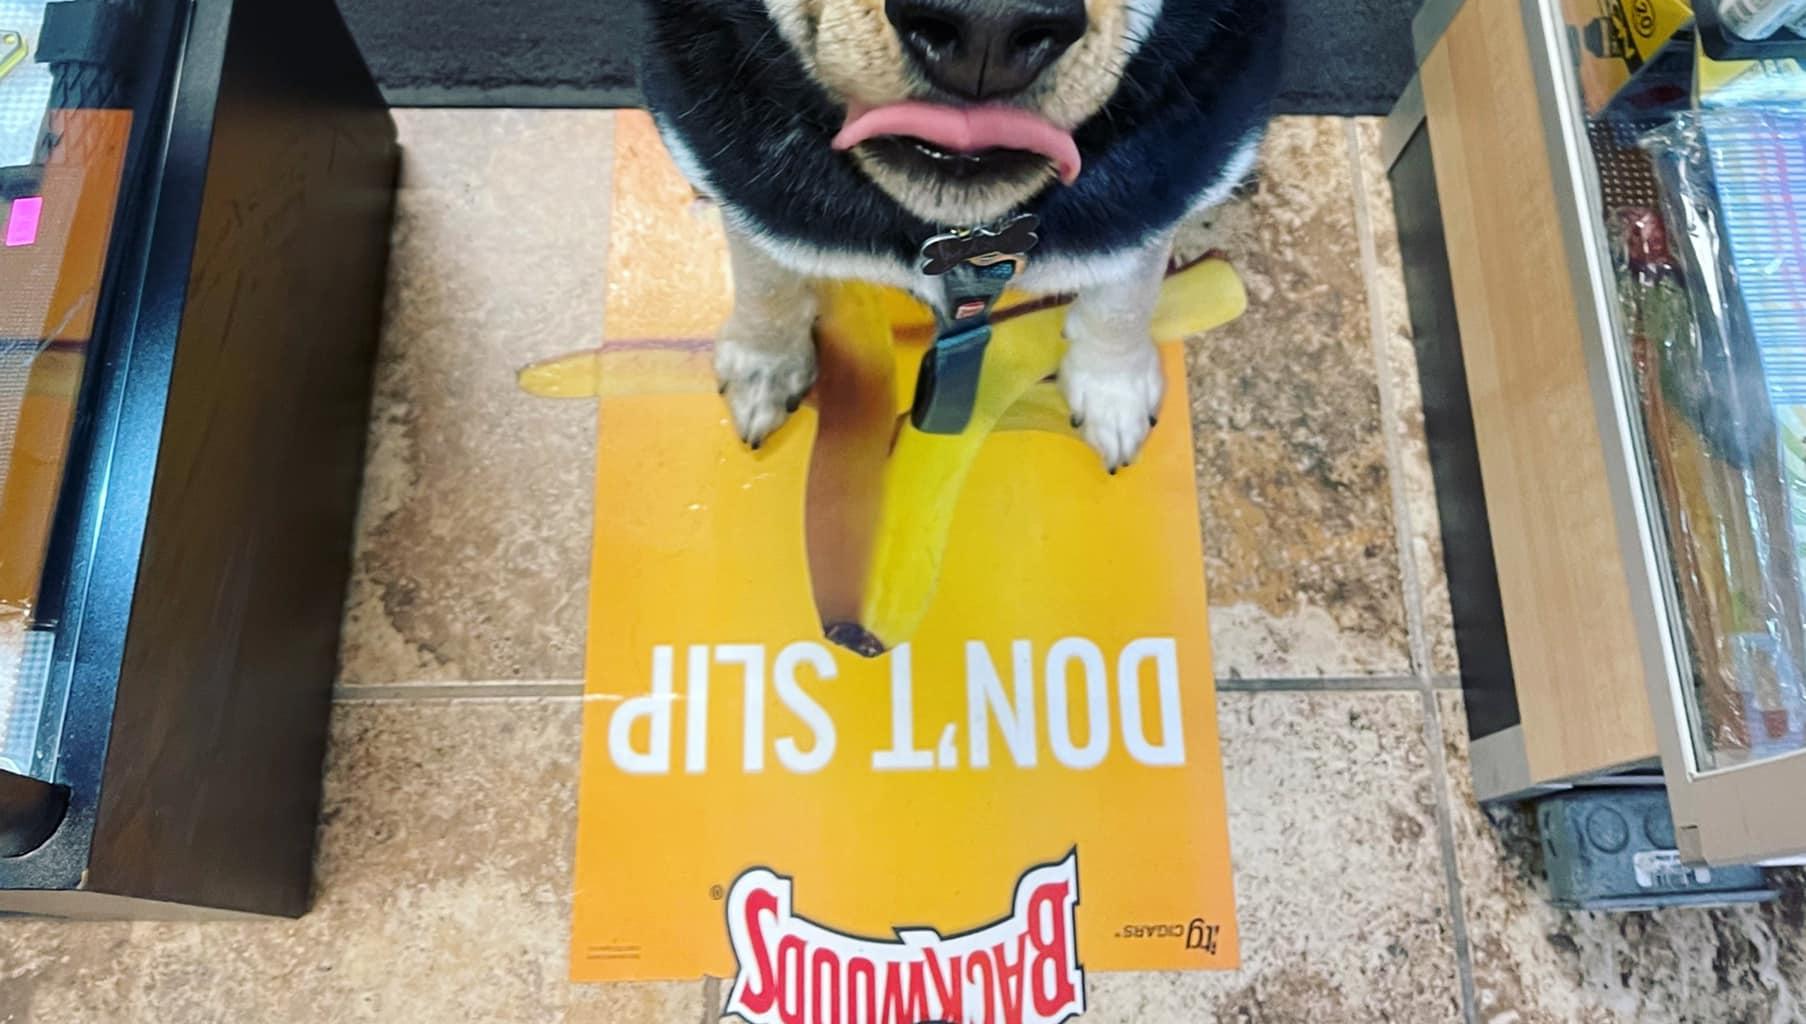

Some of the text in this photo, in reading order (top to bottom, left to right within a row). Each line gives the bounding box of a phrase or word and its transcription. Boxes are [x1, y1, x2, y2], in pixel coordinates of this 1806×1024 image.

[607, 636, 1186, 774] DON'T SLIP
[1122, 923, 1185, 939] CIGARS
